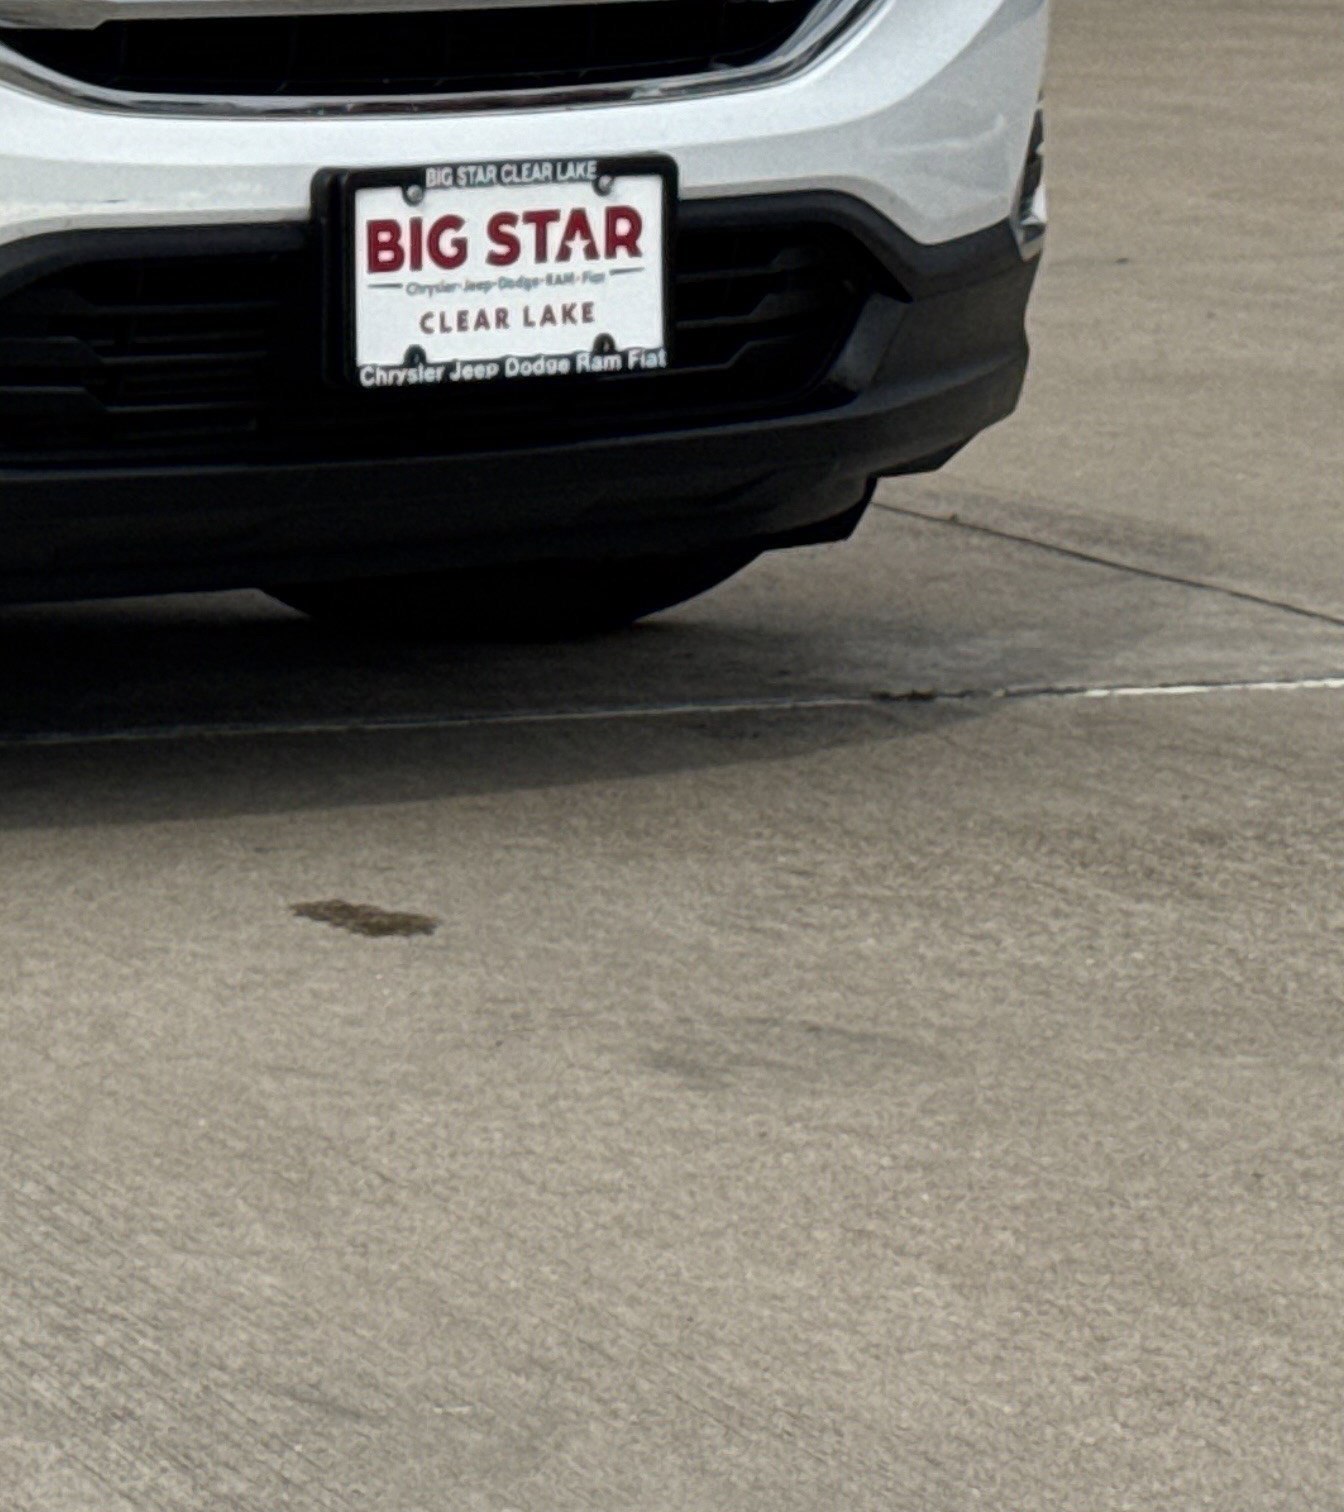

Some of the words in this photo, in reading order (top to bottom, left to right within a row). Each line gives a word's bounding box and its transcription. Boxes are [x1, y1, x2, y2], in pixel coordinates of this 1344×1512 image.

[425, 167, 453, 188] BIG
[456, 164, 497, 186] STAR
[500, 162, 554, 184] CLEAR
[556, 160, 598, 180] LAKE
[366, 214, 468, 273] BIG
[485, 205, 643, 266] STAR
[419, 307, 509, 335] CLEAR
[522, 301, 595, 328] LAKE
[359, 362, 446, 388] Chrysler
[449, 358, 499, 381] Jeep
[504, 354, 571, 378] Dodge
[576, 351, 622, 373] Ram
[627, 347, 667, 370] Fiat
